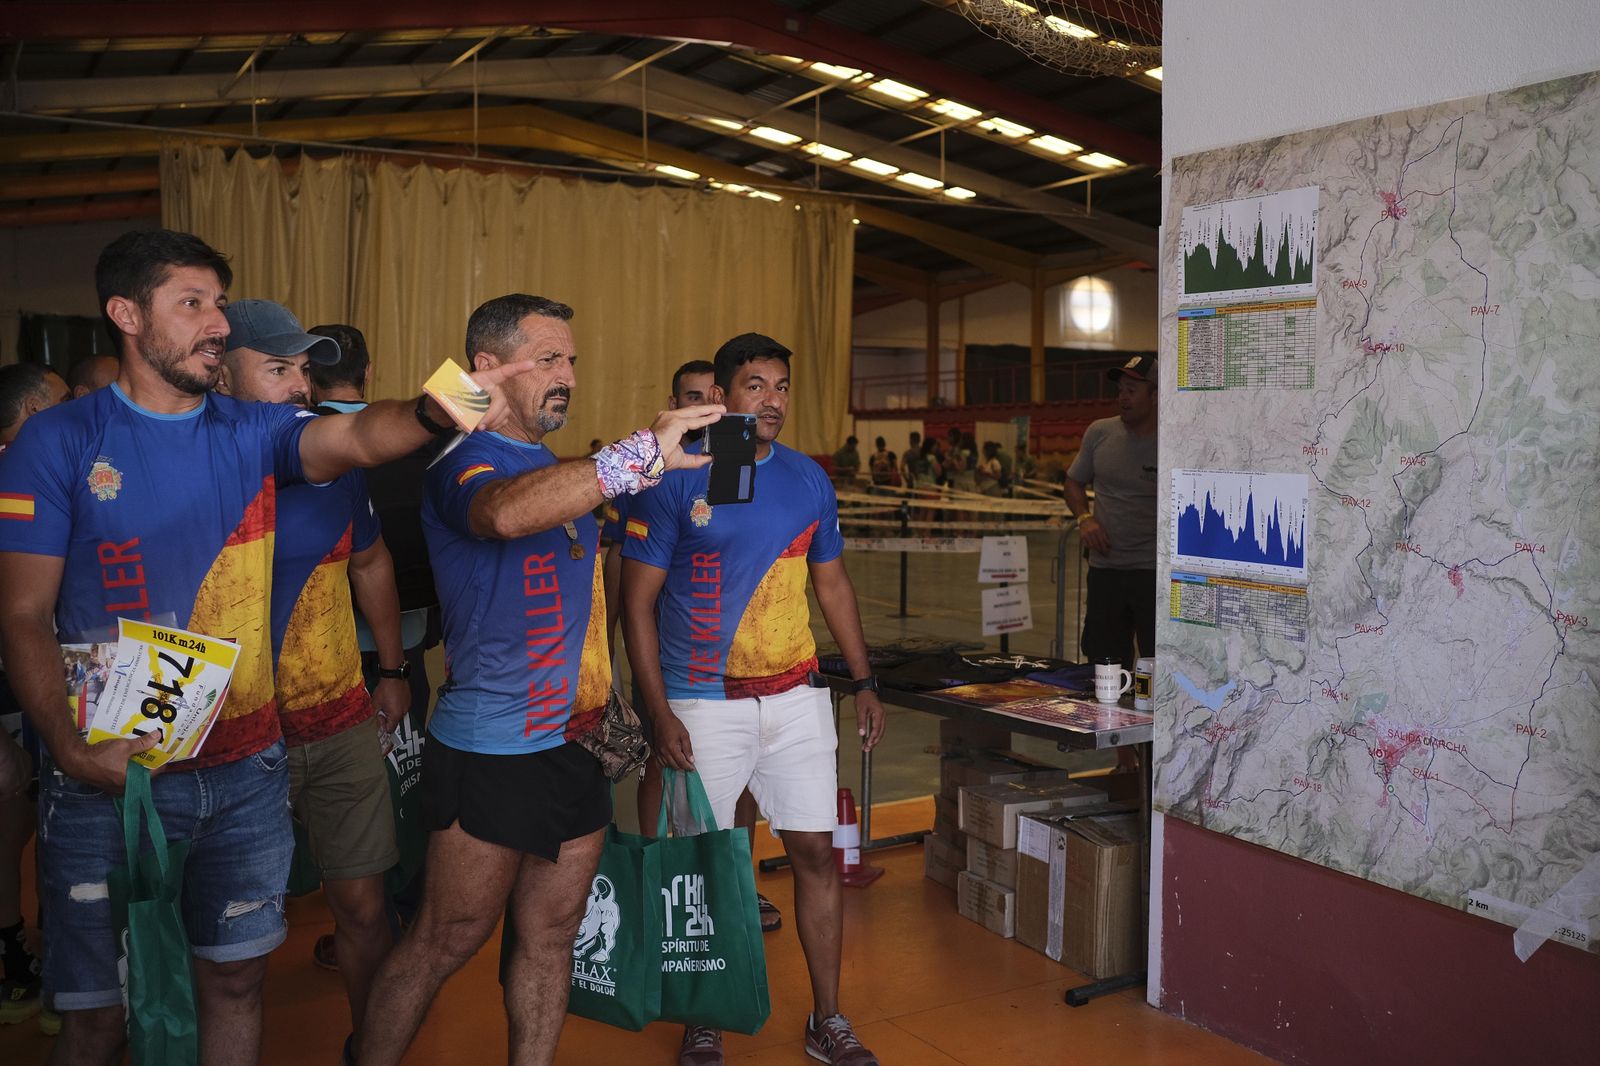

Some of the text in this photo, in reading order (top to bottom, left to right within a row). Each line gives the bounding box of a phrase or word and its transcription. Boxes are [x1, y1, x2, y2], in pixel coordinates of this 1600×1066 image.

[1342, 280, 1368, 289] PAV-9
[1470, 304, 1500, 316] PAV-7
[1374, 342, 1405, 352] PAV-10
[1302, 446, 1328, 456] PAV-11
[1400, 456, 1426, 466] PAV-6
[1342, 497, 1371, 508] PAV-12
[1395, 542, 1421, 552] PAV-5
[1514, 542, 1546, 554] PAV-4
[690, 552, 720, 641] KILLER
[1556, 612, 1588, 626] PAV-3
[524, 552, 568, 737] THE KILLER
[1388, 728, 1422, 744] SALIDA
[1516, 724, 1547, 739] PAV-2
[406, 757, 422, 772] DE
[1413, 768, 1439, 781] PAV-1
[1294, 778, 1322, 792] PAV-18
[1476, 900, 1488, 910] km
[579, 980, 587, 989] EL
[590, 982, 615, 996] DOLOR
